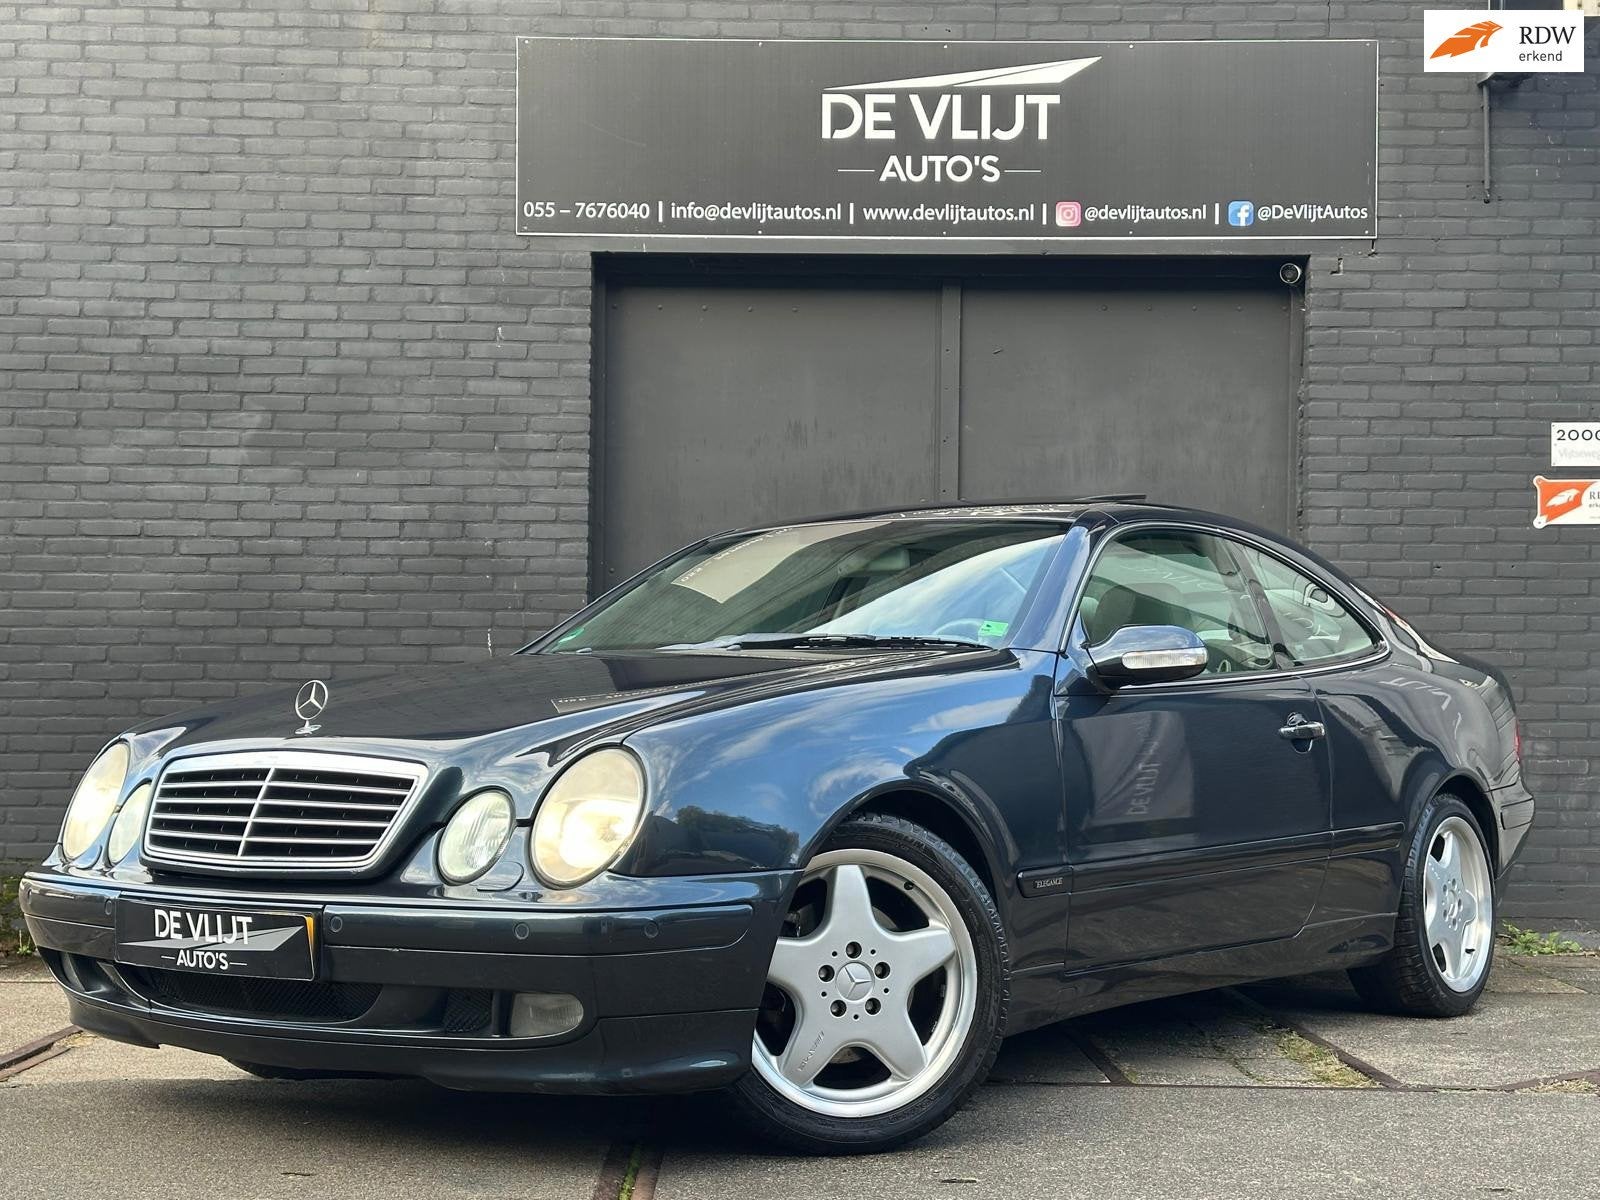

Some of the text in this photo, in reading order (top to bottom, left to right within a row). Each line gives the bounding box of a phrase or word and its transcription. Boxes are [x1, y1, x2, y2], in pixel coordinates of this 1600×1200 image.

[821, 93, 1061, 142] DE VLIJT
[879, 154, 1001, 184] AUTO'S
[523, 201, 556, 218] 055
[574, 202, 650, 219] 7676040
[671, 202, 842, 224] info@devlijtautos.nl
[862, 203, 1035, 225] www.devlijtautos.nl
[1084, 204, 1207, 224] @devlijtautos.nl
[1257, 203, 1368, 223] @DeVlijtAutos
[153, 908, 253, 945] DE VLIJT
[176, 949, 230, 971] AUTO'S
